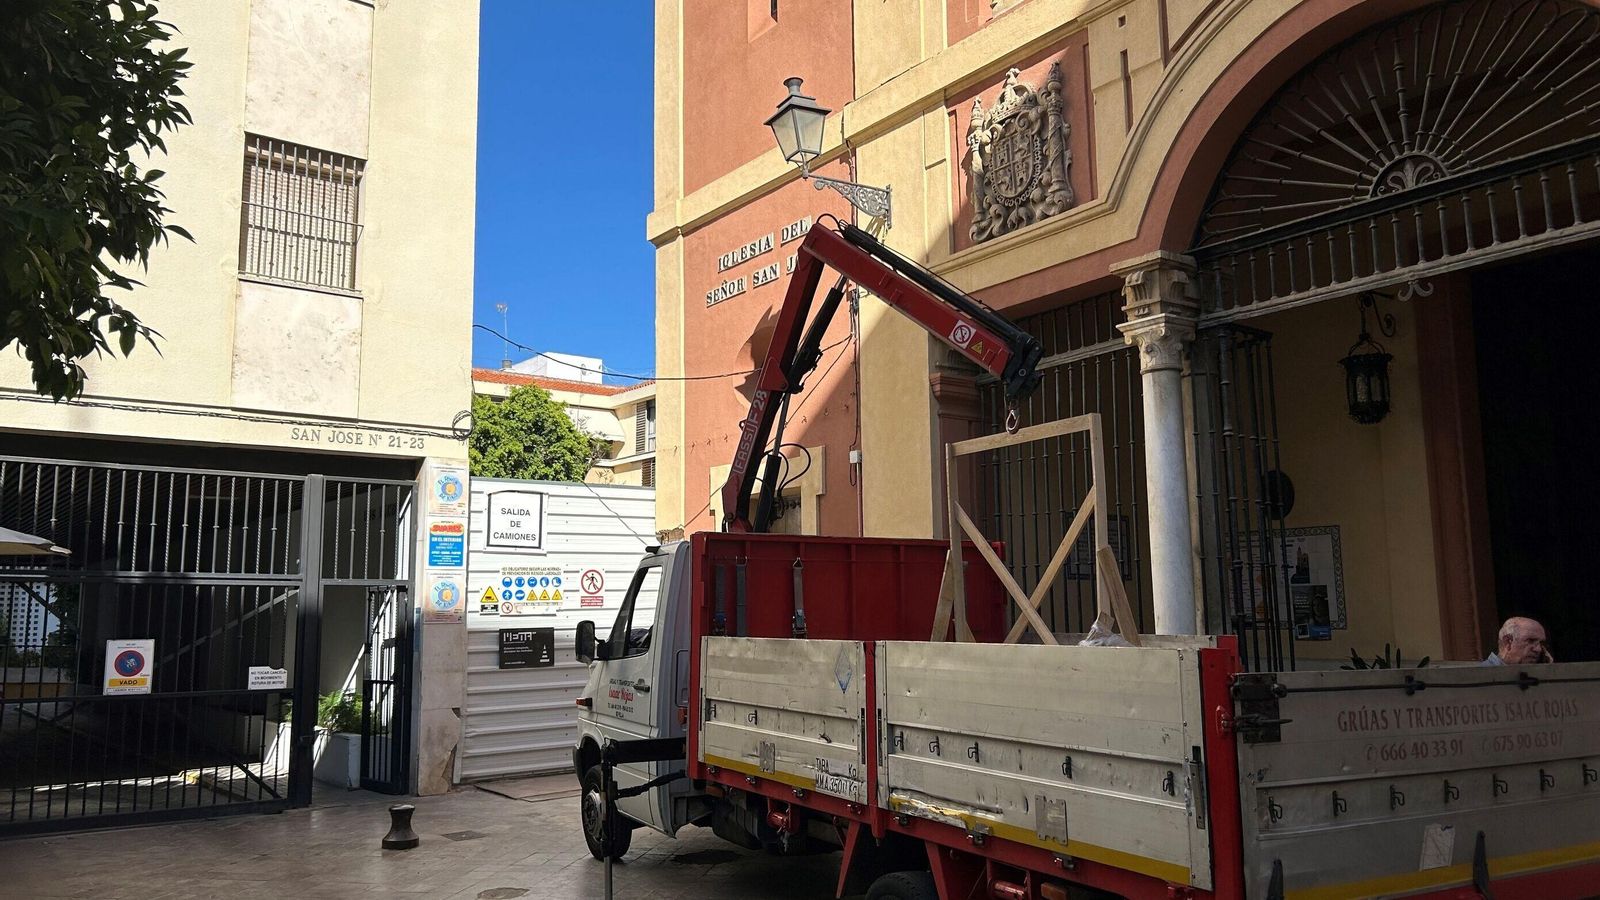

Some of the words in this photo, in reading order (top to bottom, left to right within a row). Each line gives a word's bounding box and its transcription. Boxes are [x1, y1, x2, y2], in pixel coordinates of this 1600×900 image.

[718, 235, 772, 272] IGLESIA
[781, 219, 809, 238] DEL
[706, 278, 745, 305] SEÑOR
[753, 263, 778, 285] SAN
[291, 427, 321, 442] SAN
[328, 430, 363, 445] JOSE
[388, 435, 425, 449] 21-23
[734, 425, 756, 470] FASSI
[501, 507, 531, 517] SALIDA
[510, 520, 522, 528] DE
[493, 531, 537, 542] CAMIONES
[1337, 705, 1389, 732] GRÚAS
[1393, 709, 1401, 729] Y
[1406, 703, 1499, 729] TRANSPORTES
[1505, 701, 1539, 722] ISAAC
[1545, 698, 1578, 721] ROJAS
[1381, 743, 1407, 762] 666
[1412, 741, 1429, 759] 40
[1432, 739, 1447, 756] 33
[1450, 739, 1464, 755] 91
[1493, 734, 1514, 752] 675
[1517, 733, 1532, 749] 90
[1535, 732, 1549, 748] 63
[1551, 730, 1564, 746] 07
